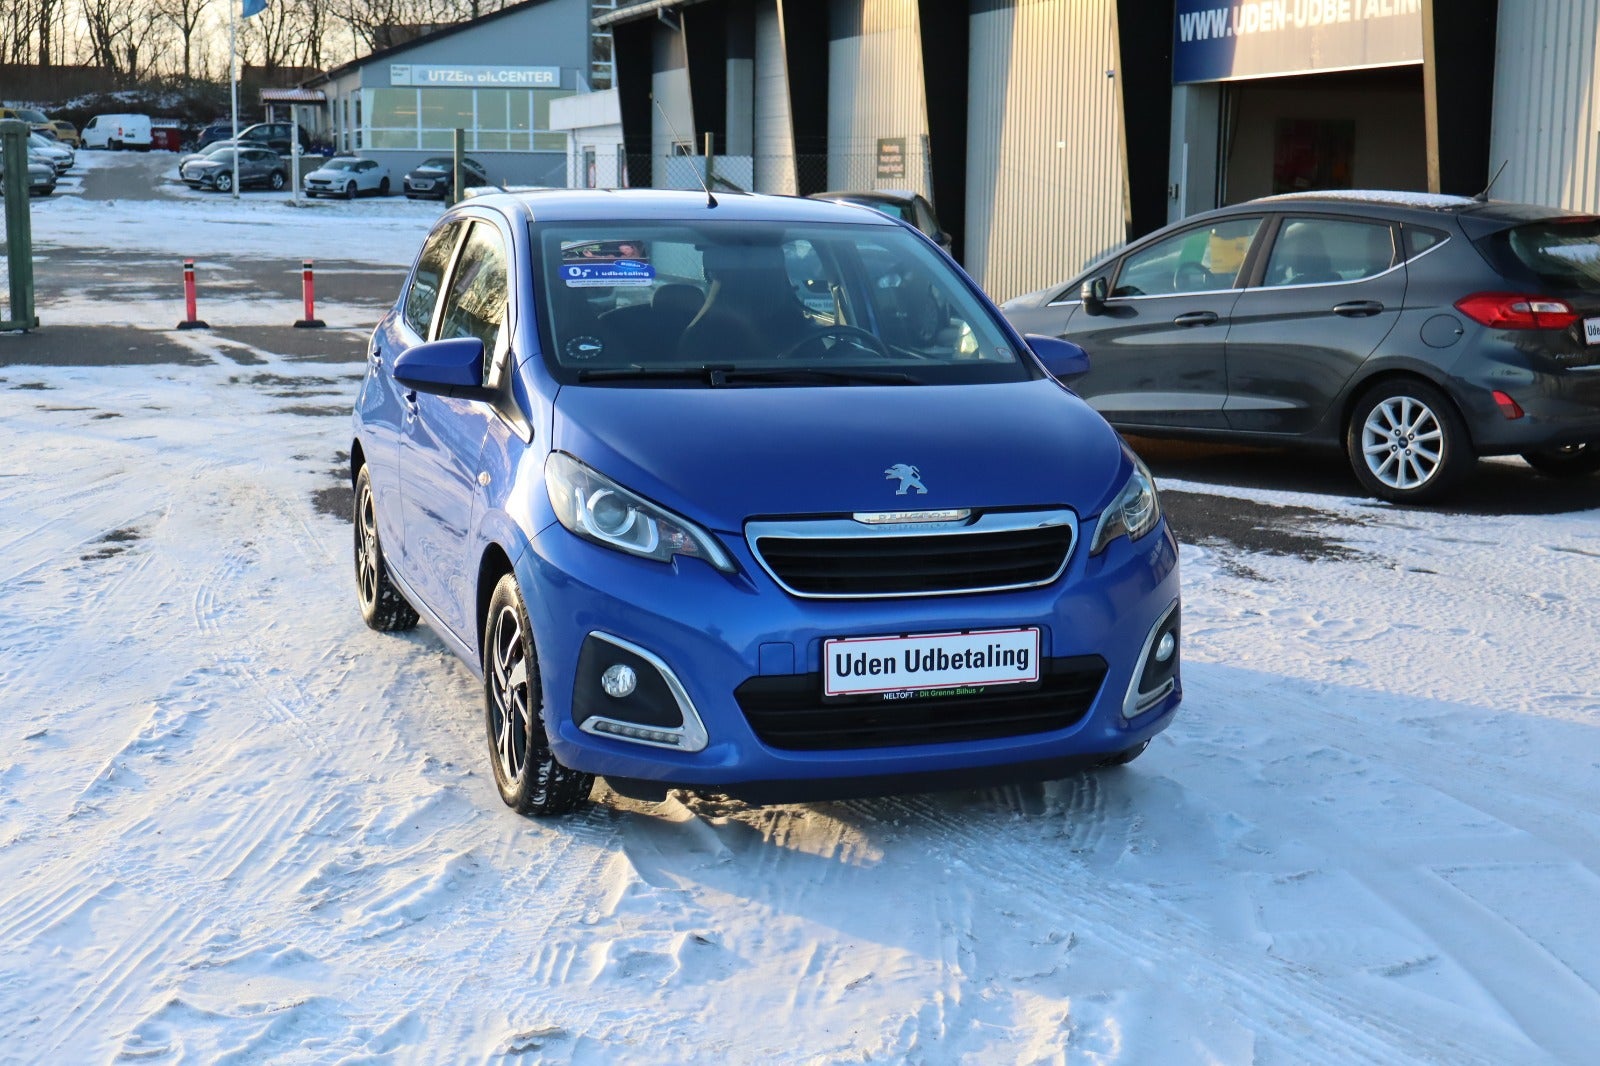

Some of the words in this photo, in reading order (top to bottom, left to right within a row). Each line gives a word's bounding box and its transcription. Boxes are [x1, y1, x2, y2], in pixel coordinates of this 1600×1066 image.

[1180, 0, 1421, 42] WWW.UDEN-UDBETALIN
[836, 652, 897, 678] Uden
[904, 644, 1029, 673] Udbetaling
[883, 691, 914, 700] NELTOFT
